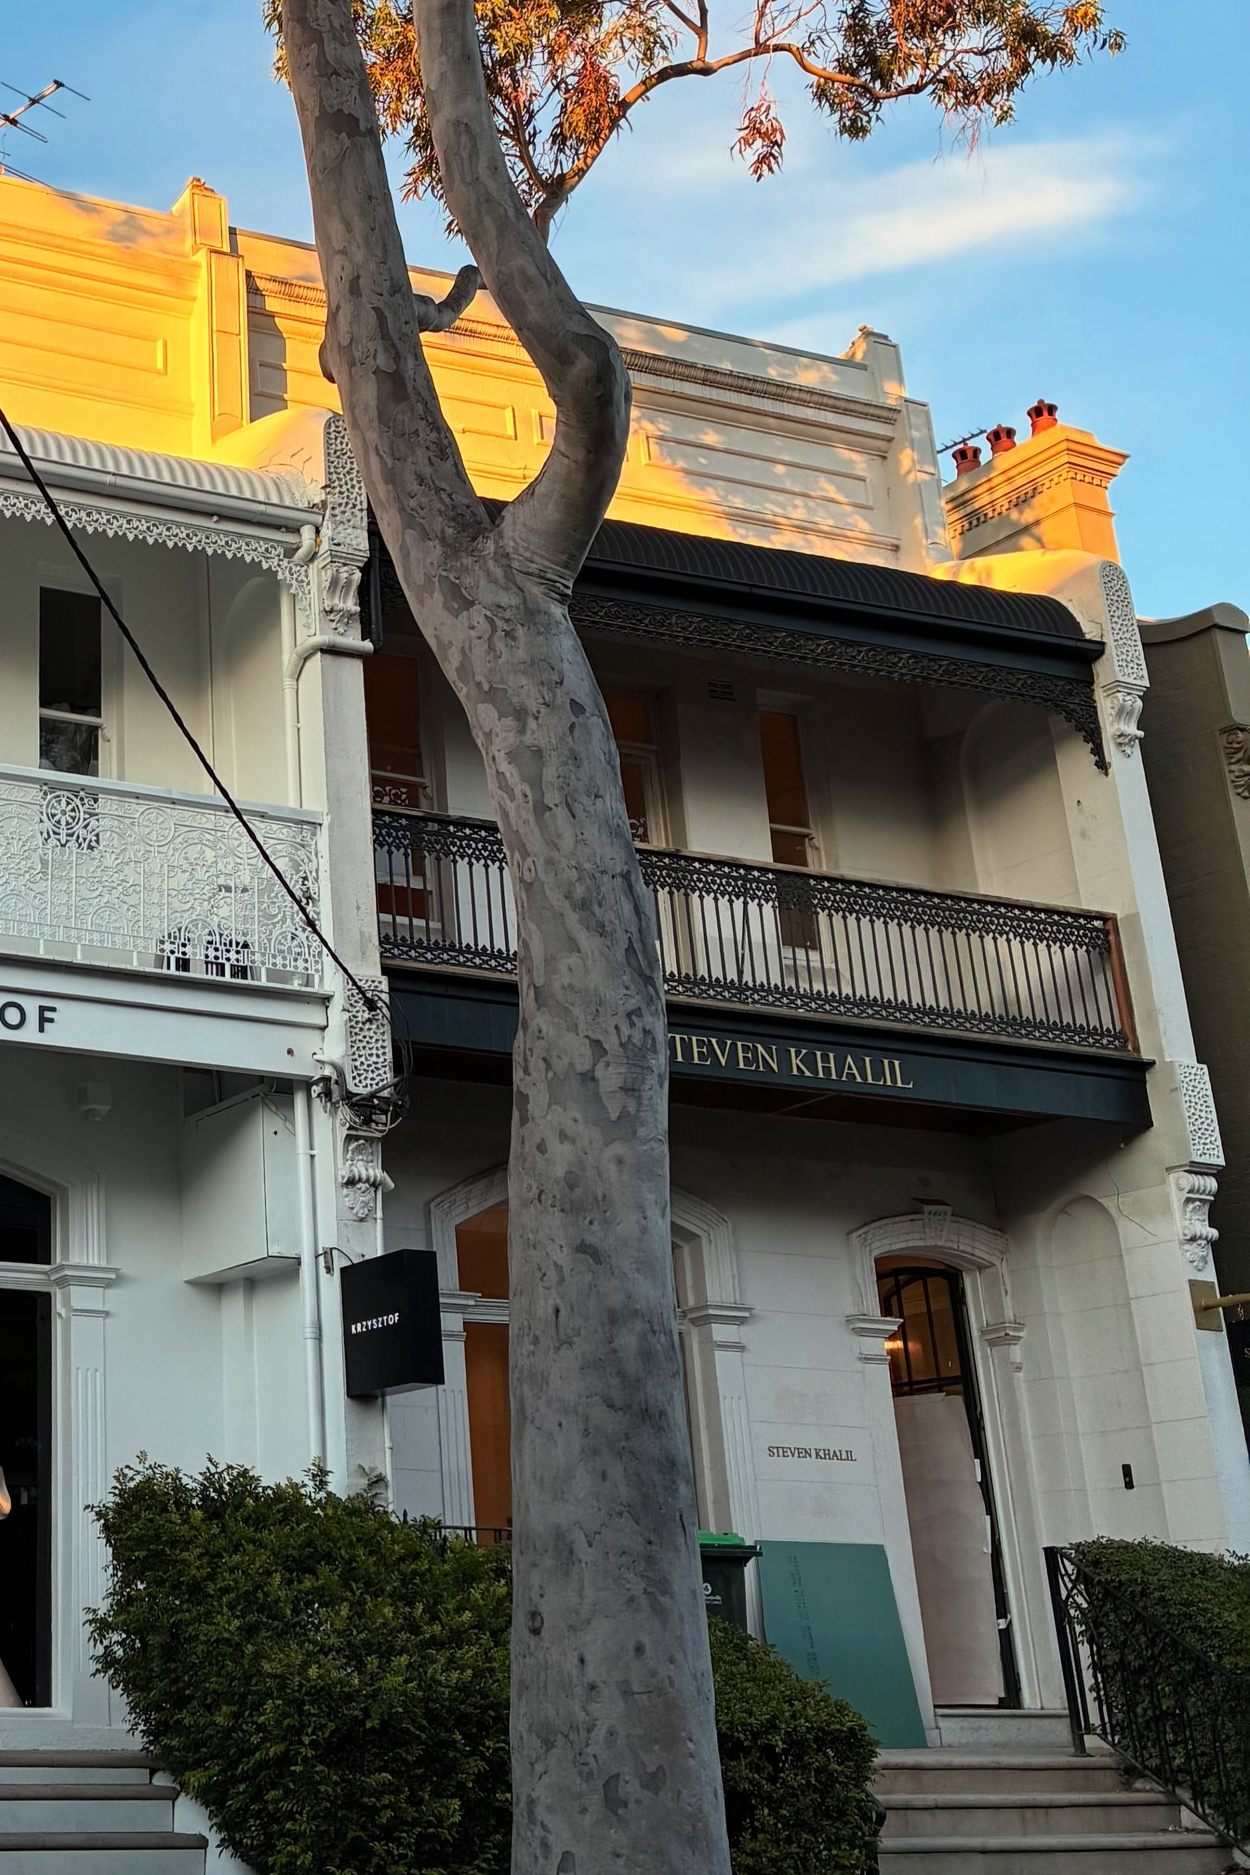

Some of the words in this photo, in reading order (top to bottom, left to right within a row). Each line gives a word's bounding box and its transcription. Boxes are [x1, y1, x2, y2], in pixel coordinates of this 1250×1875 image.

[668, 1033, 779, 1074] TEVEN
[788, 1047, 914, 1089] KHALIL
[350, 1312, 400, 1335] KRZYSZTOF
[767, 1445, 812, 1459] STEVEN
[814, 1447, 857, 1462] KHALIL
